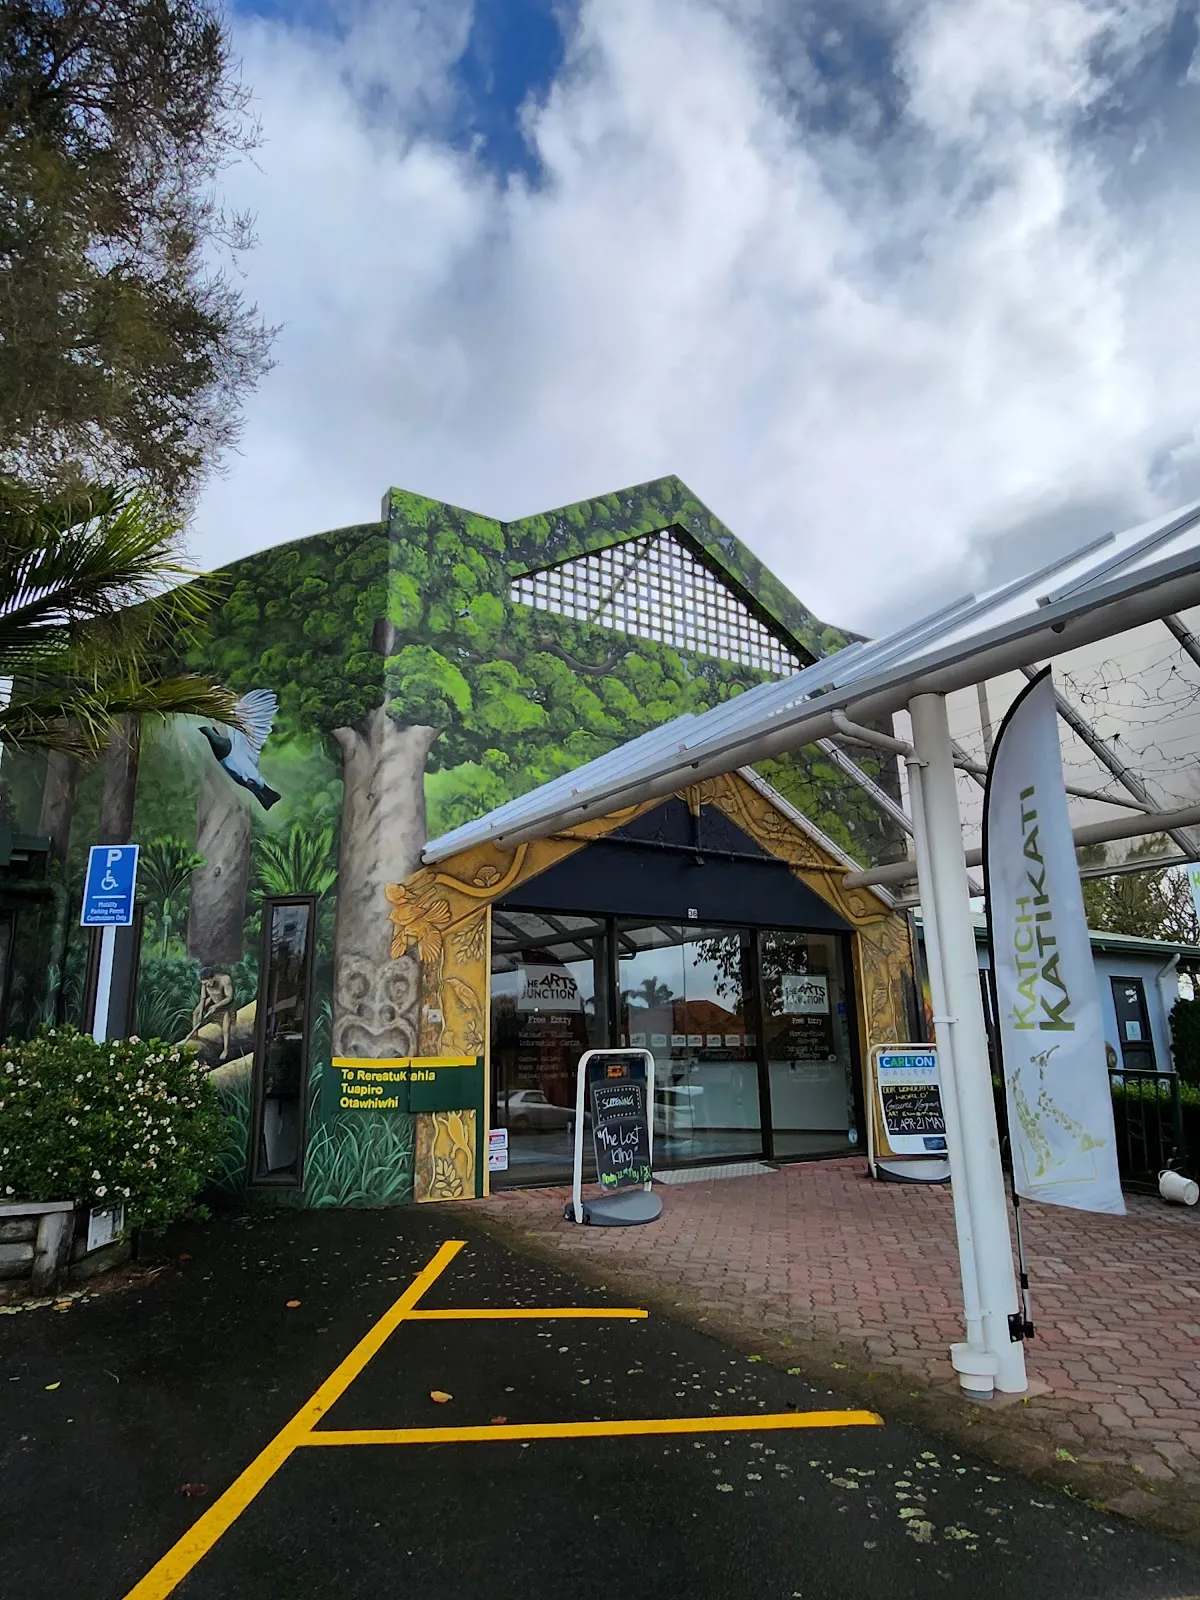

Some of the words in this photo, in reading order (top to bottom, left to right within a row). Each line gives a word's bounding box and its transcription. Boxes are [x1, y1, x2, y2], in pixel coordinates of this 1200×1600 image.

[106, 849, 122, 867] P
[1020, 785, 1075, 1031] KATIKATI
[1014, 896, 1039, 1029] KATCH
[539, 972, 577, 991] ARTS
[521, 985, 575, 1000] JUNCTION
[882, 1056, 933, 1067] CARLTON
[341, 1068, 355, 1080] Te
[341, 1082, 384, 1096] Tuapiro
[340, 1096, 399, 1109] Otawhiwhi
[926, 1116, 945, 1130] MAY
[619, 1124, 643, 1146] Lost
